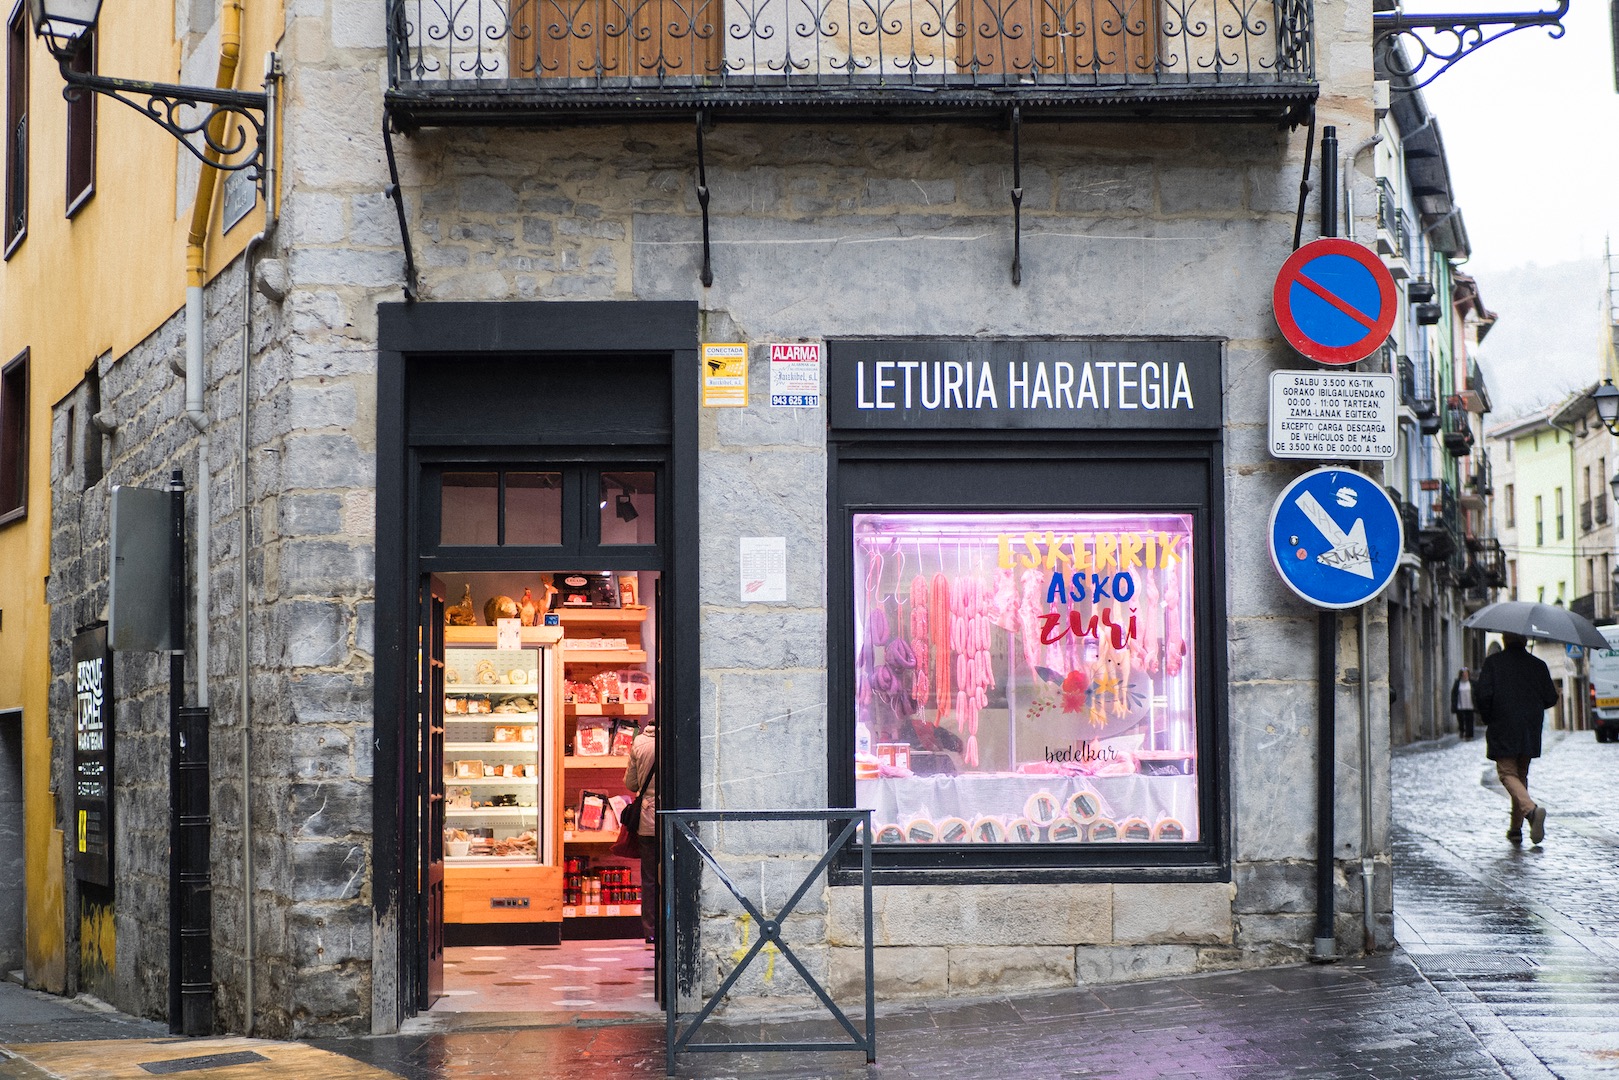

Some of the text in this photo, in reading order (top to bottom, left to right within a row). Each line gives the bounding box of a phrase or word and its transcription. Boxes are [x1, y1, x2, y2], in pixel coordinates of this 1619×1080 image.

[773, 346, 818, 360] ALARMA
[857, 361, 1194, 409] LETURIA HARATEGIA
[1294, 378, 1319, 386] SALBU
[1323, 379, 1346, 387] 3.500
[1283, 388, 1385, 398] GORAKO IBILGAILUENDAKO
[773, 396, 817, 405] 943 625 181
[1287, 398, 1311, 406] 00:00
[1320, 399, 1339, 407] 11:00
[1290, 409, 1378, 419] ZAMA-LANAK EGITEKO
[1282, 422, 1386, 433] EXCEPTO CARGA DESCARGA
[1291, 432, 1377, 443] DE VEHÍCULOS DE MÁS
[1276, 443, 1391, 454] DE 3.500 KG DE 00:00 A 11:00
[1046, 571, 1135, 604] ASKO
[1045, 740, 1120, 763] bedelkar
